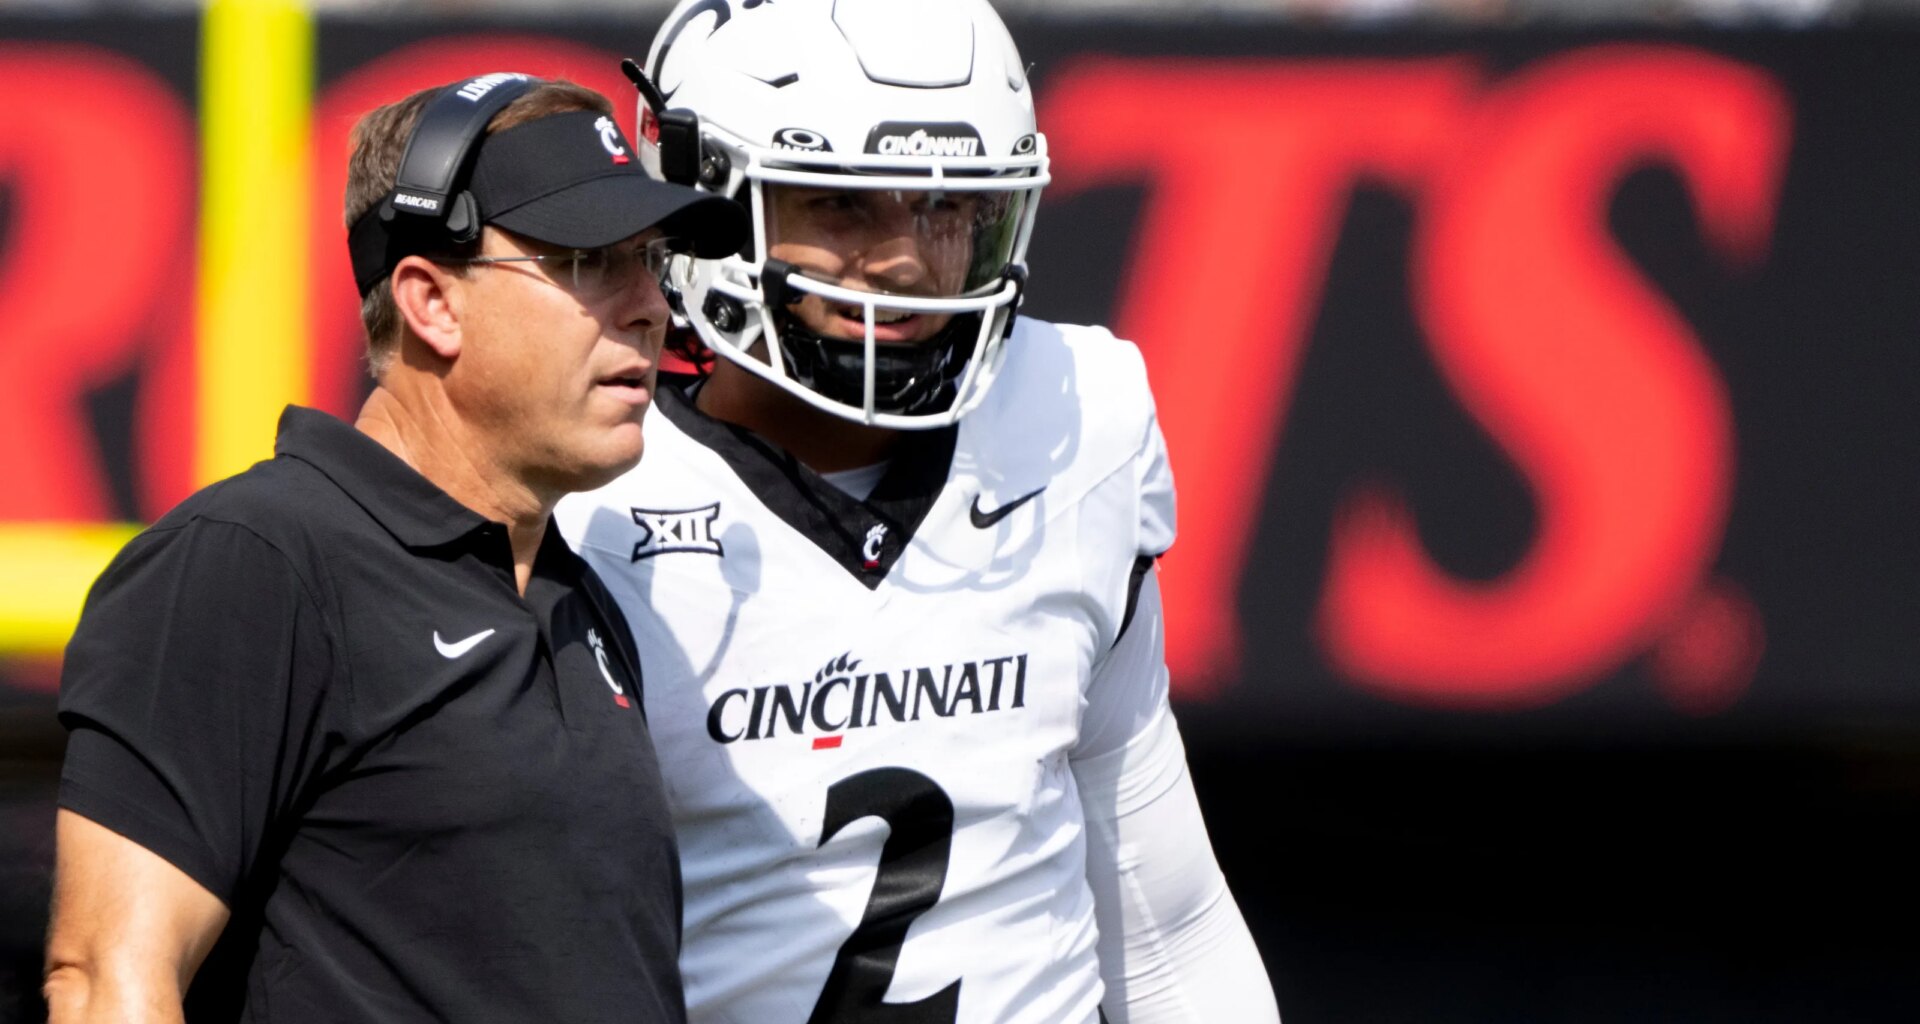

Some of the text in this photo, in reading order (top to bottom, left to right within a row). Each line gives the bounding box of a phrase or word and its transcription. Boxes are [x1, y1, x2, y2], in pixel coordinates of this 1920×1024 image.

[878, 130, 979, 155] CINCINNATI
[395, 193, 438, 209] BEARCATS
[633, 504, 721, 559] XII
[707, 653, 1028, 746] CINCINNATI
[807, 765, 961, 1024] 2
